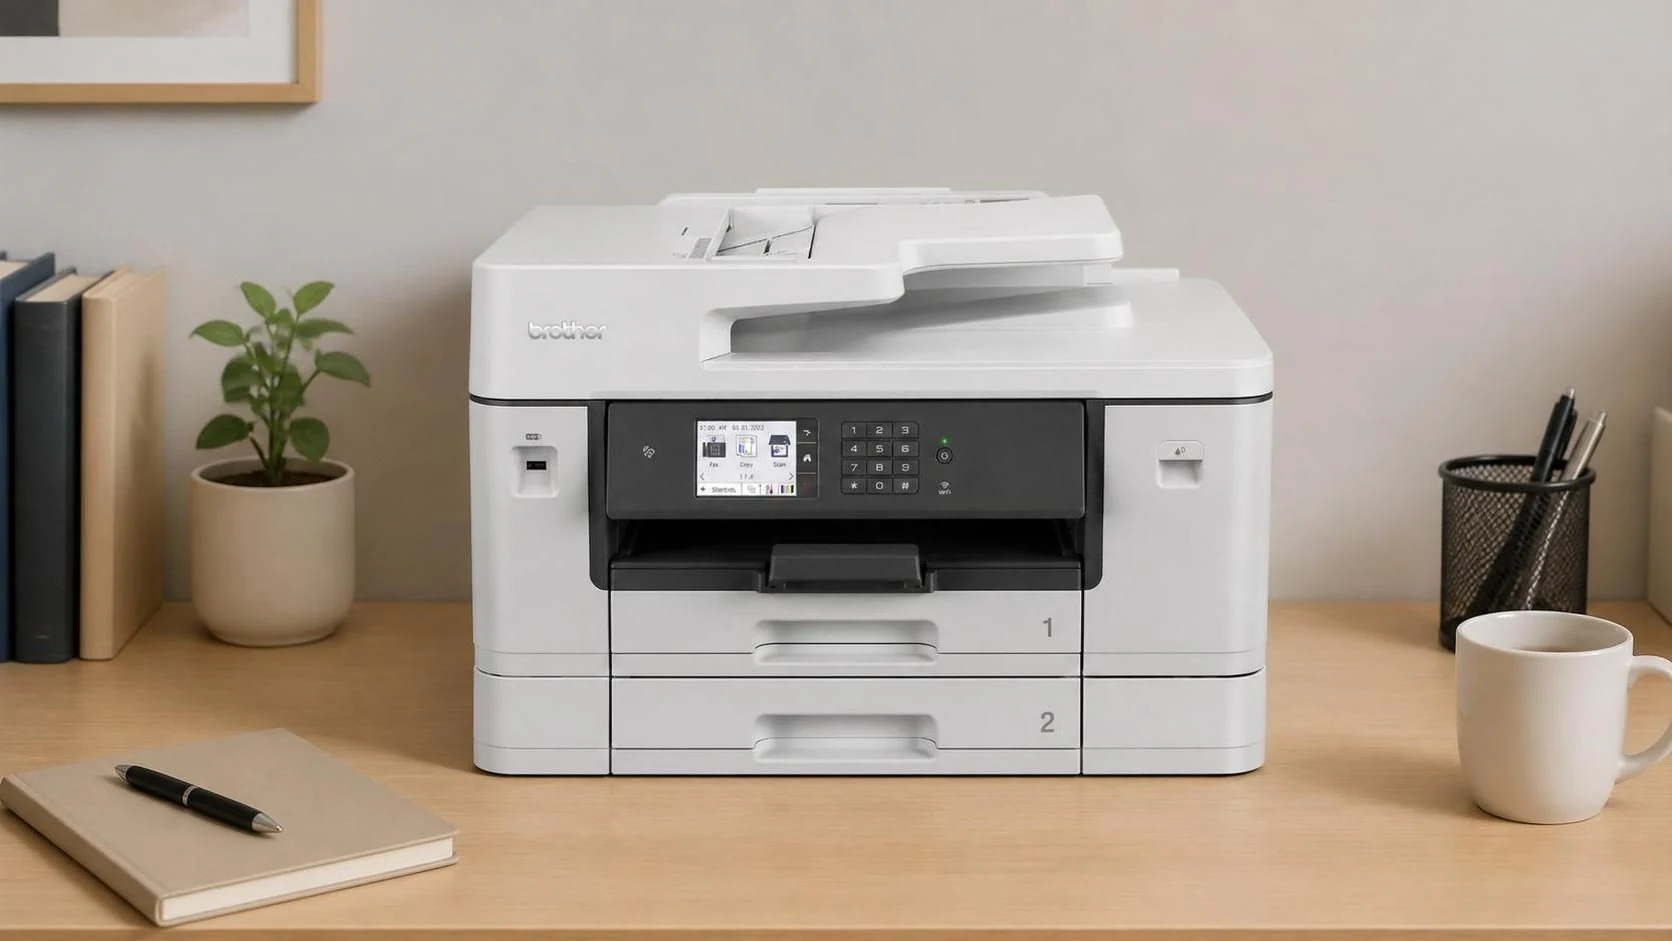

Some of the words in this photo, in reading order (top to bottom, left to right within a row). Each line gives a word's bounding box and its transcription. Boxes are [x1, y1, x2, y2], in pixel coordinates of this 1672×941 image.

[528, 320, 608, 340] brother
[875, 426, 884, 434] 2
[901, 426, 910, 434] 3
[850, 445, 858, 453] 4
[875, 445, 884, 453] 5
[901, 445, 910, 453] 6
[851, 463, 858, 472] 7
[875, 463, 884, 472] 8
[901, 463, 910, 472] 9
[1042, 617, 1052, 638] 1
[1040, 711, 1055, 733] 2
